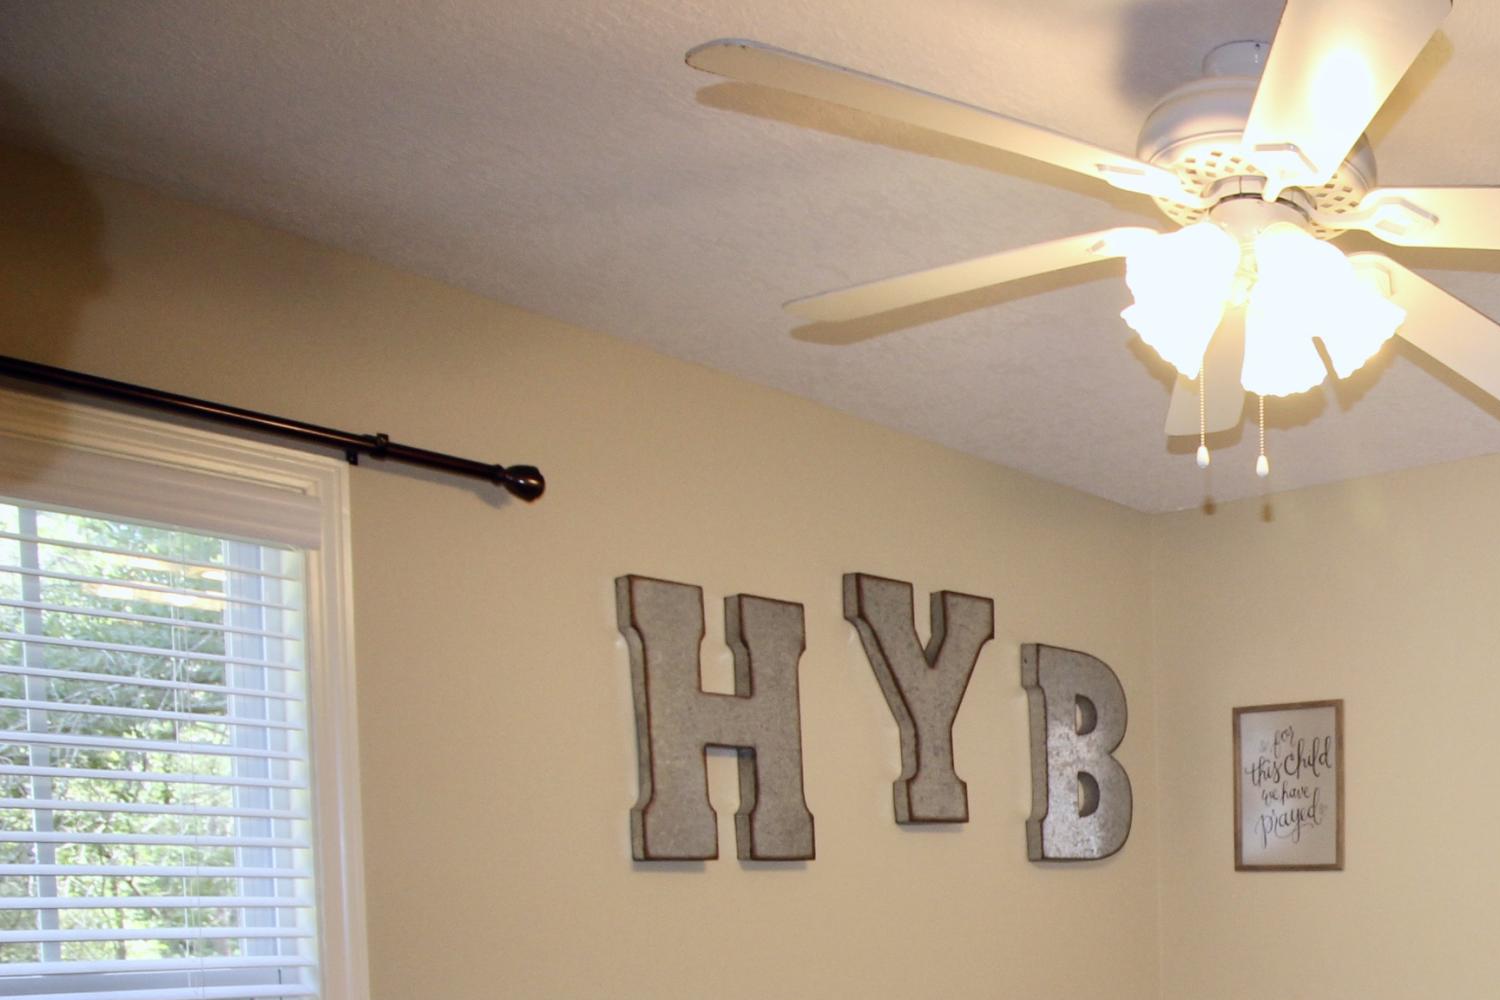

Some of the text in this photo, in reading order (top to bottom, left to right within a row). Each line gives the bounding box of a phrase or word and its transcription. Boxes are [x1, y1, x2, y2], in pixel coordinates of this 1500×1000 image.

[1245, 755, 1283, 787] this
[1281, 779, 1311, 805] have
[1255, 786, 1322, 849] prayed
